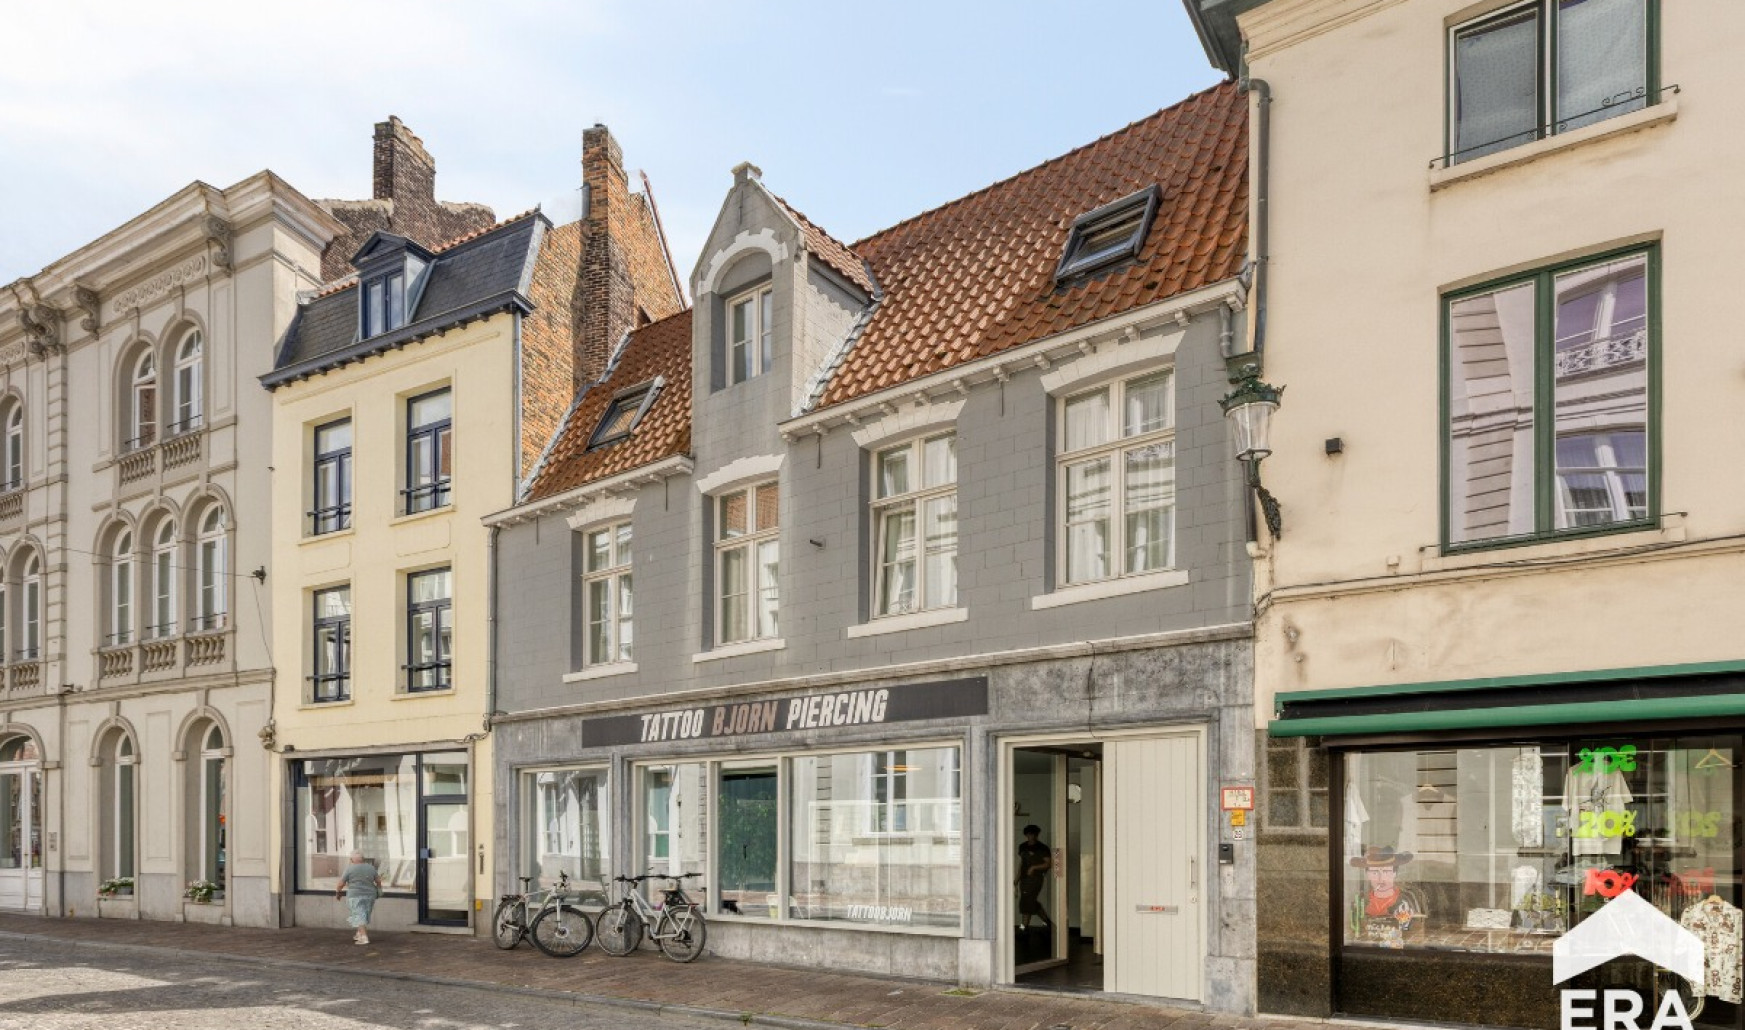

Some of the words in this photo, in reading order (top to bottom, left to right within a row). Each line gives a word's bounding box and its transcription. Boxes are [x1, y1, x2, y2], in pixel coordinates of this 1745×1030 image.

[640, 709, 705, 742] TATTOO
[711, 701, 779, 736] BJORN
[786, 689, 889, 730] PIERCING
[1576, 809, 1638, 838] 20%
